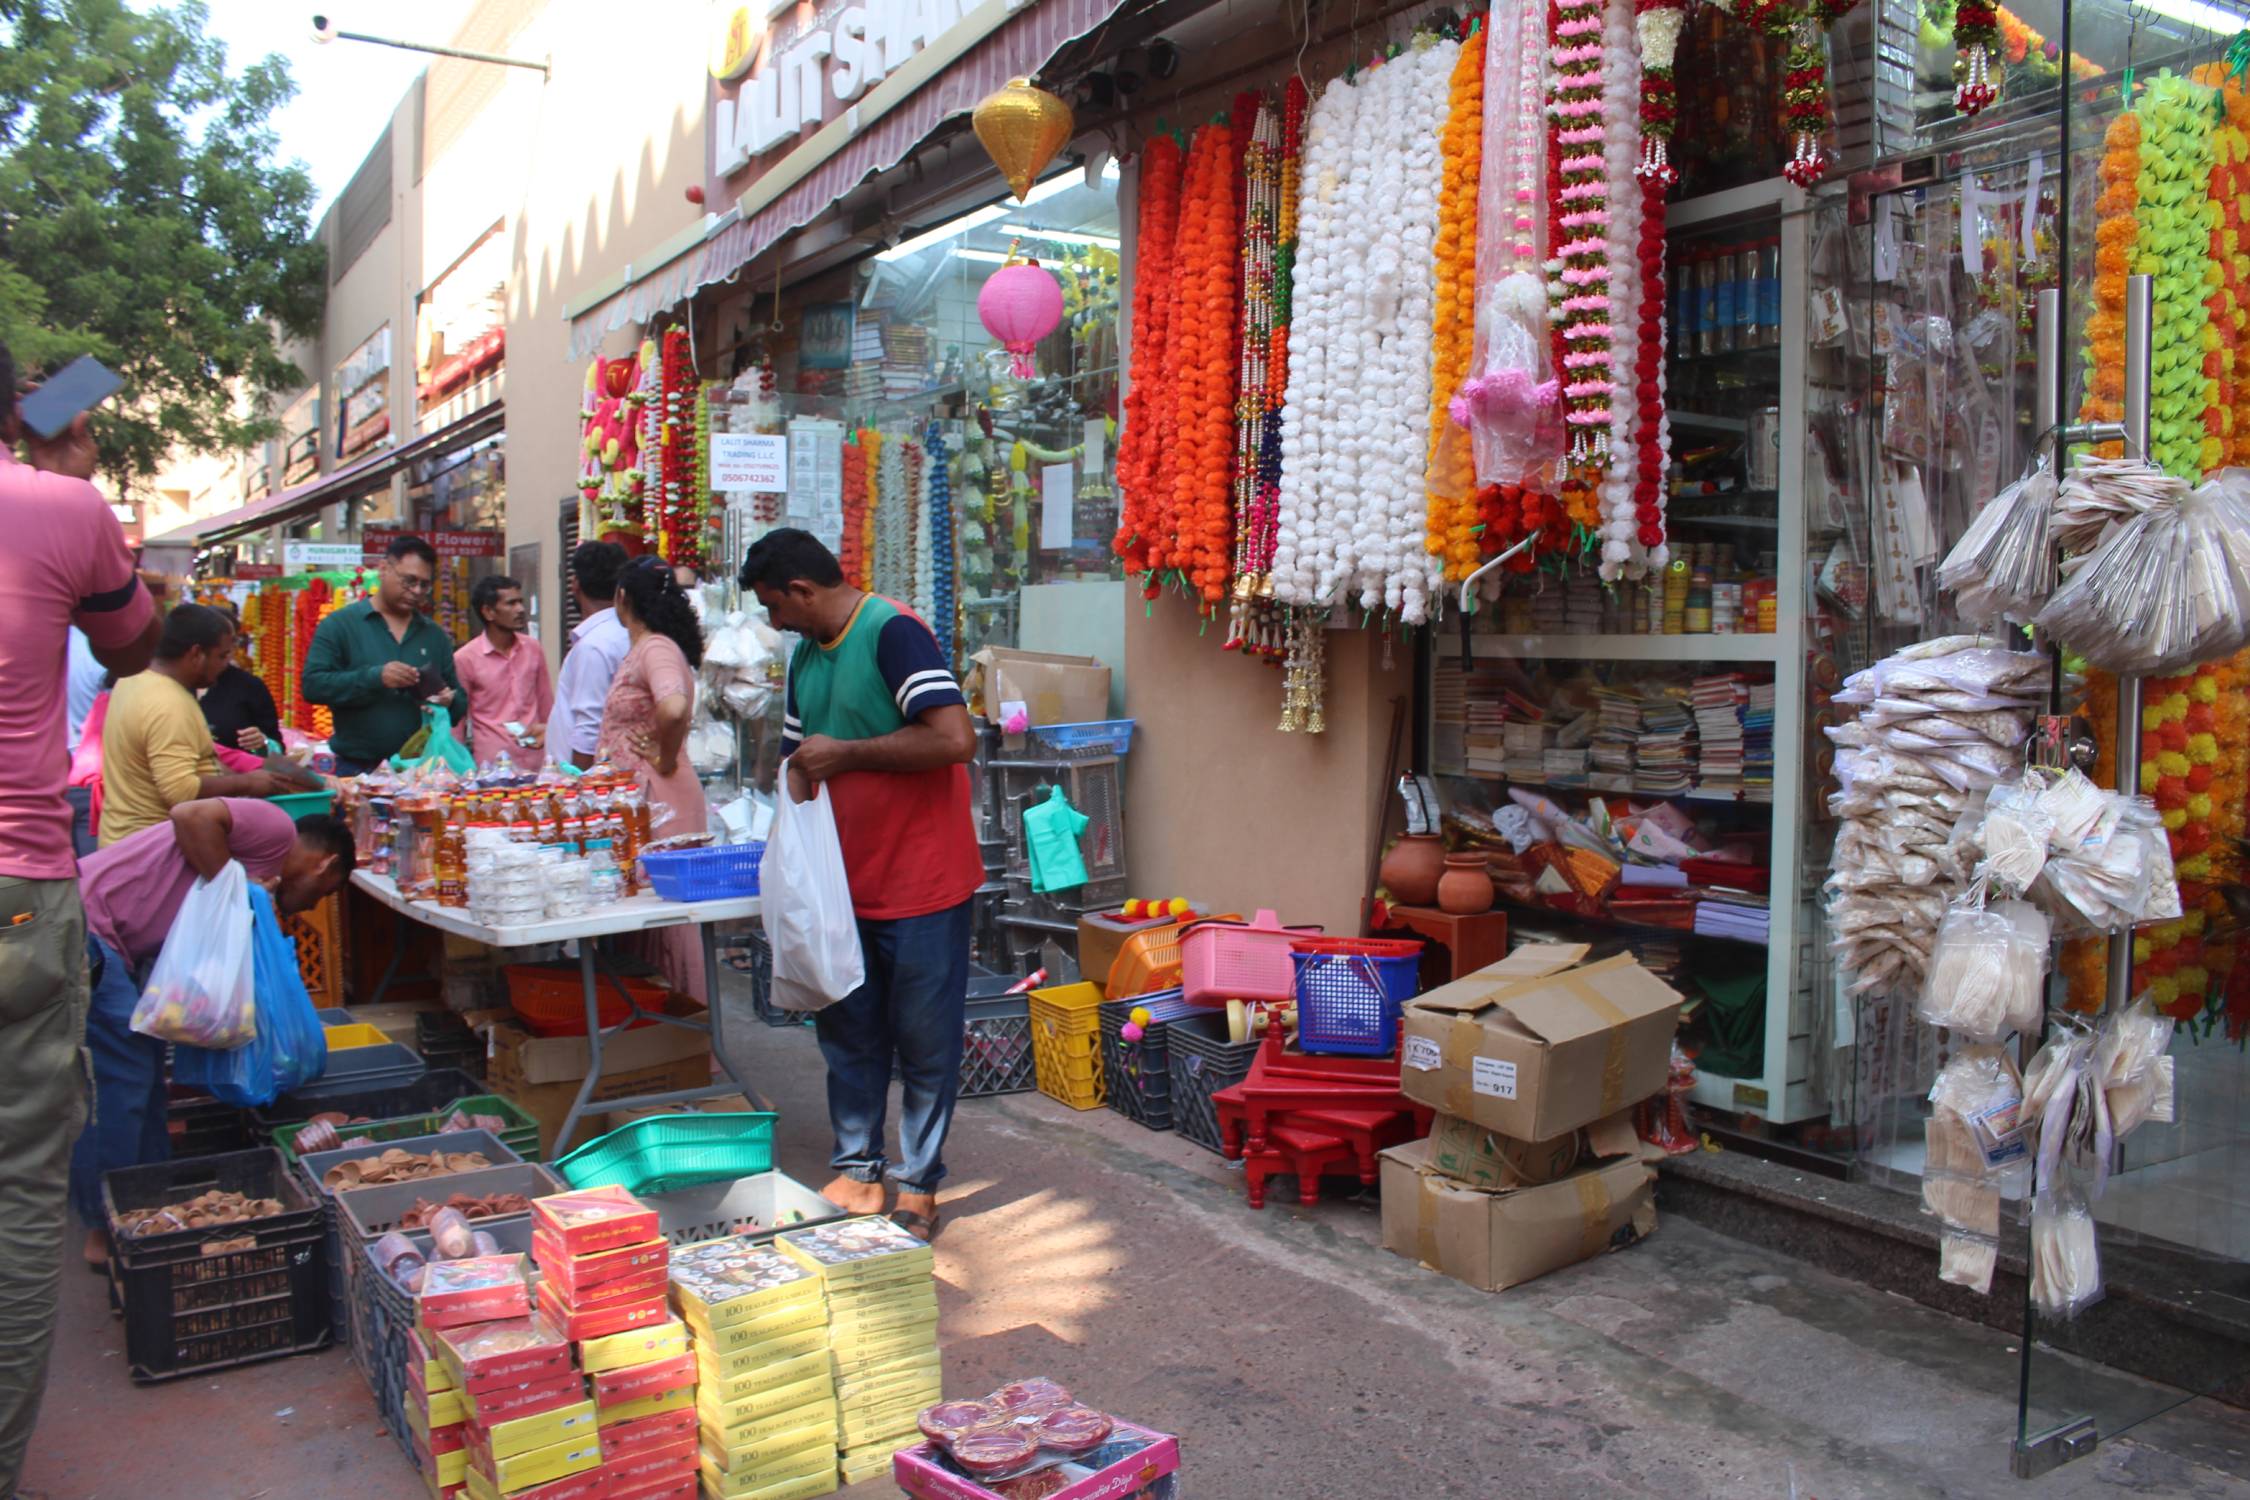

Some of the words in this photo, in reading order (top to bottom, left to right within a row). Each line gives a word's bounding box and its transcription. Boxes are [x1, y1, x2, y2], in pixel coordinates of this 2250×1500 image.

[715, 29, 832, 177] LALIT
[720, 438, 742, 446] LALIT
[743, 439, 775, 447] SHARMA
[722, 450, 756, 459] TRADING
[435, 532, 496, 545] Flowers
[1492, 1082, 1513, 1095] 917
[725, 1303, 743, 1318] 100
[730, 1330, 748, 1344] 100
[733, 1355, 750, 1369] 100
[734, 1380, 751, 1393] 100
[736, 1403, 753, 1417] 100
[739, 1426, 756, 1440] 100
[741, 1450, 759, 1463] 100
[739, 1473, 757, 1487] 100
